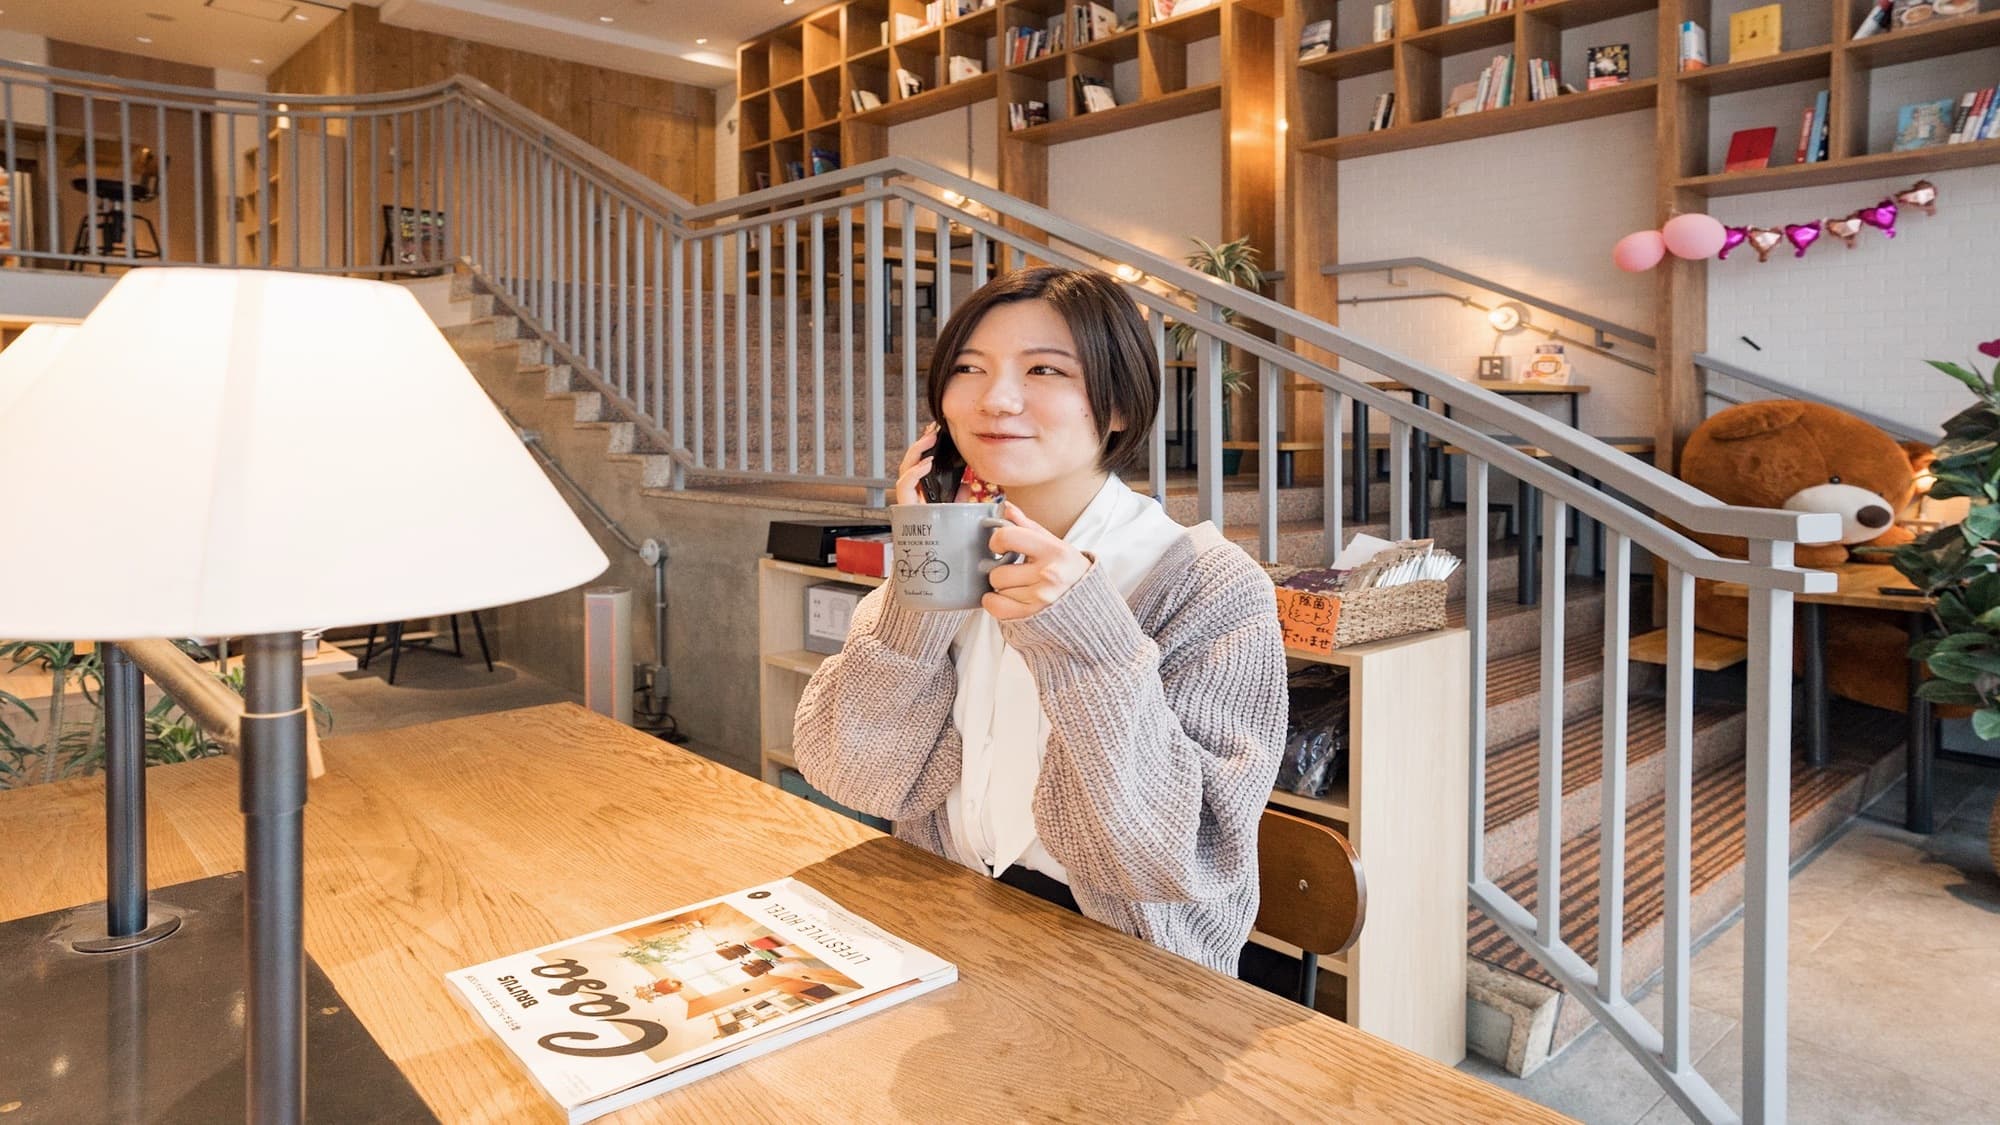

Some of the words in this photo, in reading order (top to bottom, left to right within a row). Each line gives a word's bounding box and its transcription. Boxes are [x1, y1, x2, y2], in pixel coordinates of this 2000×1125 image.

[902, 524, 932, 536] JOURNEY
[1299, 596, 1325, 609] 除菌
[764, 903, 806, 926] HOTEL
[797, 924, 871, 965] LIFESTYLE
[497, 975, 539, 1009] BRUTUS
[530, 958, 669, 1058] Casa
